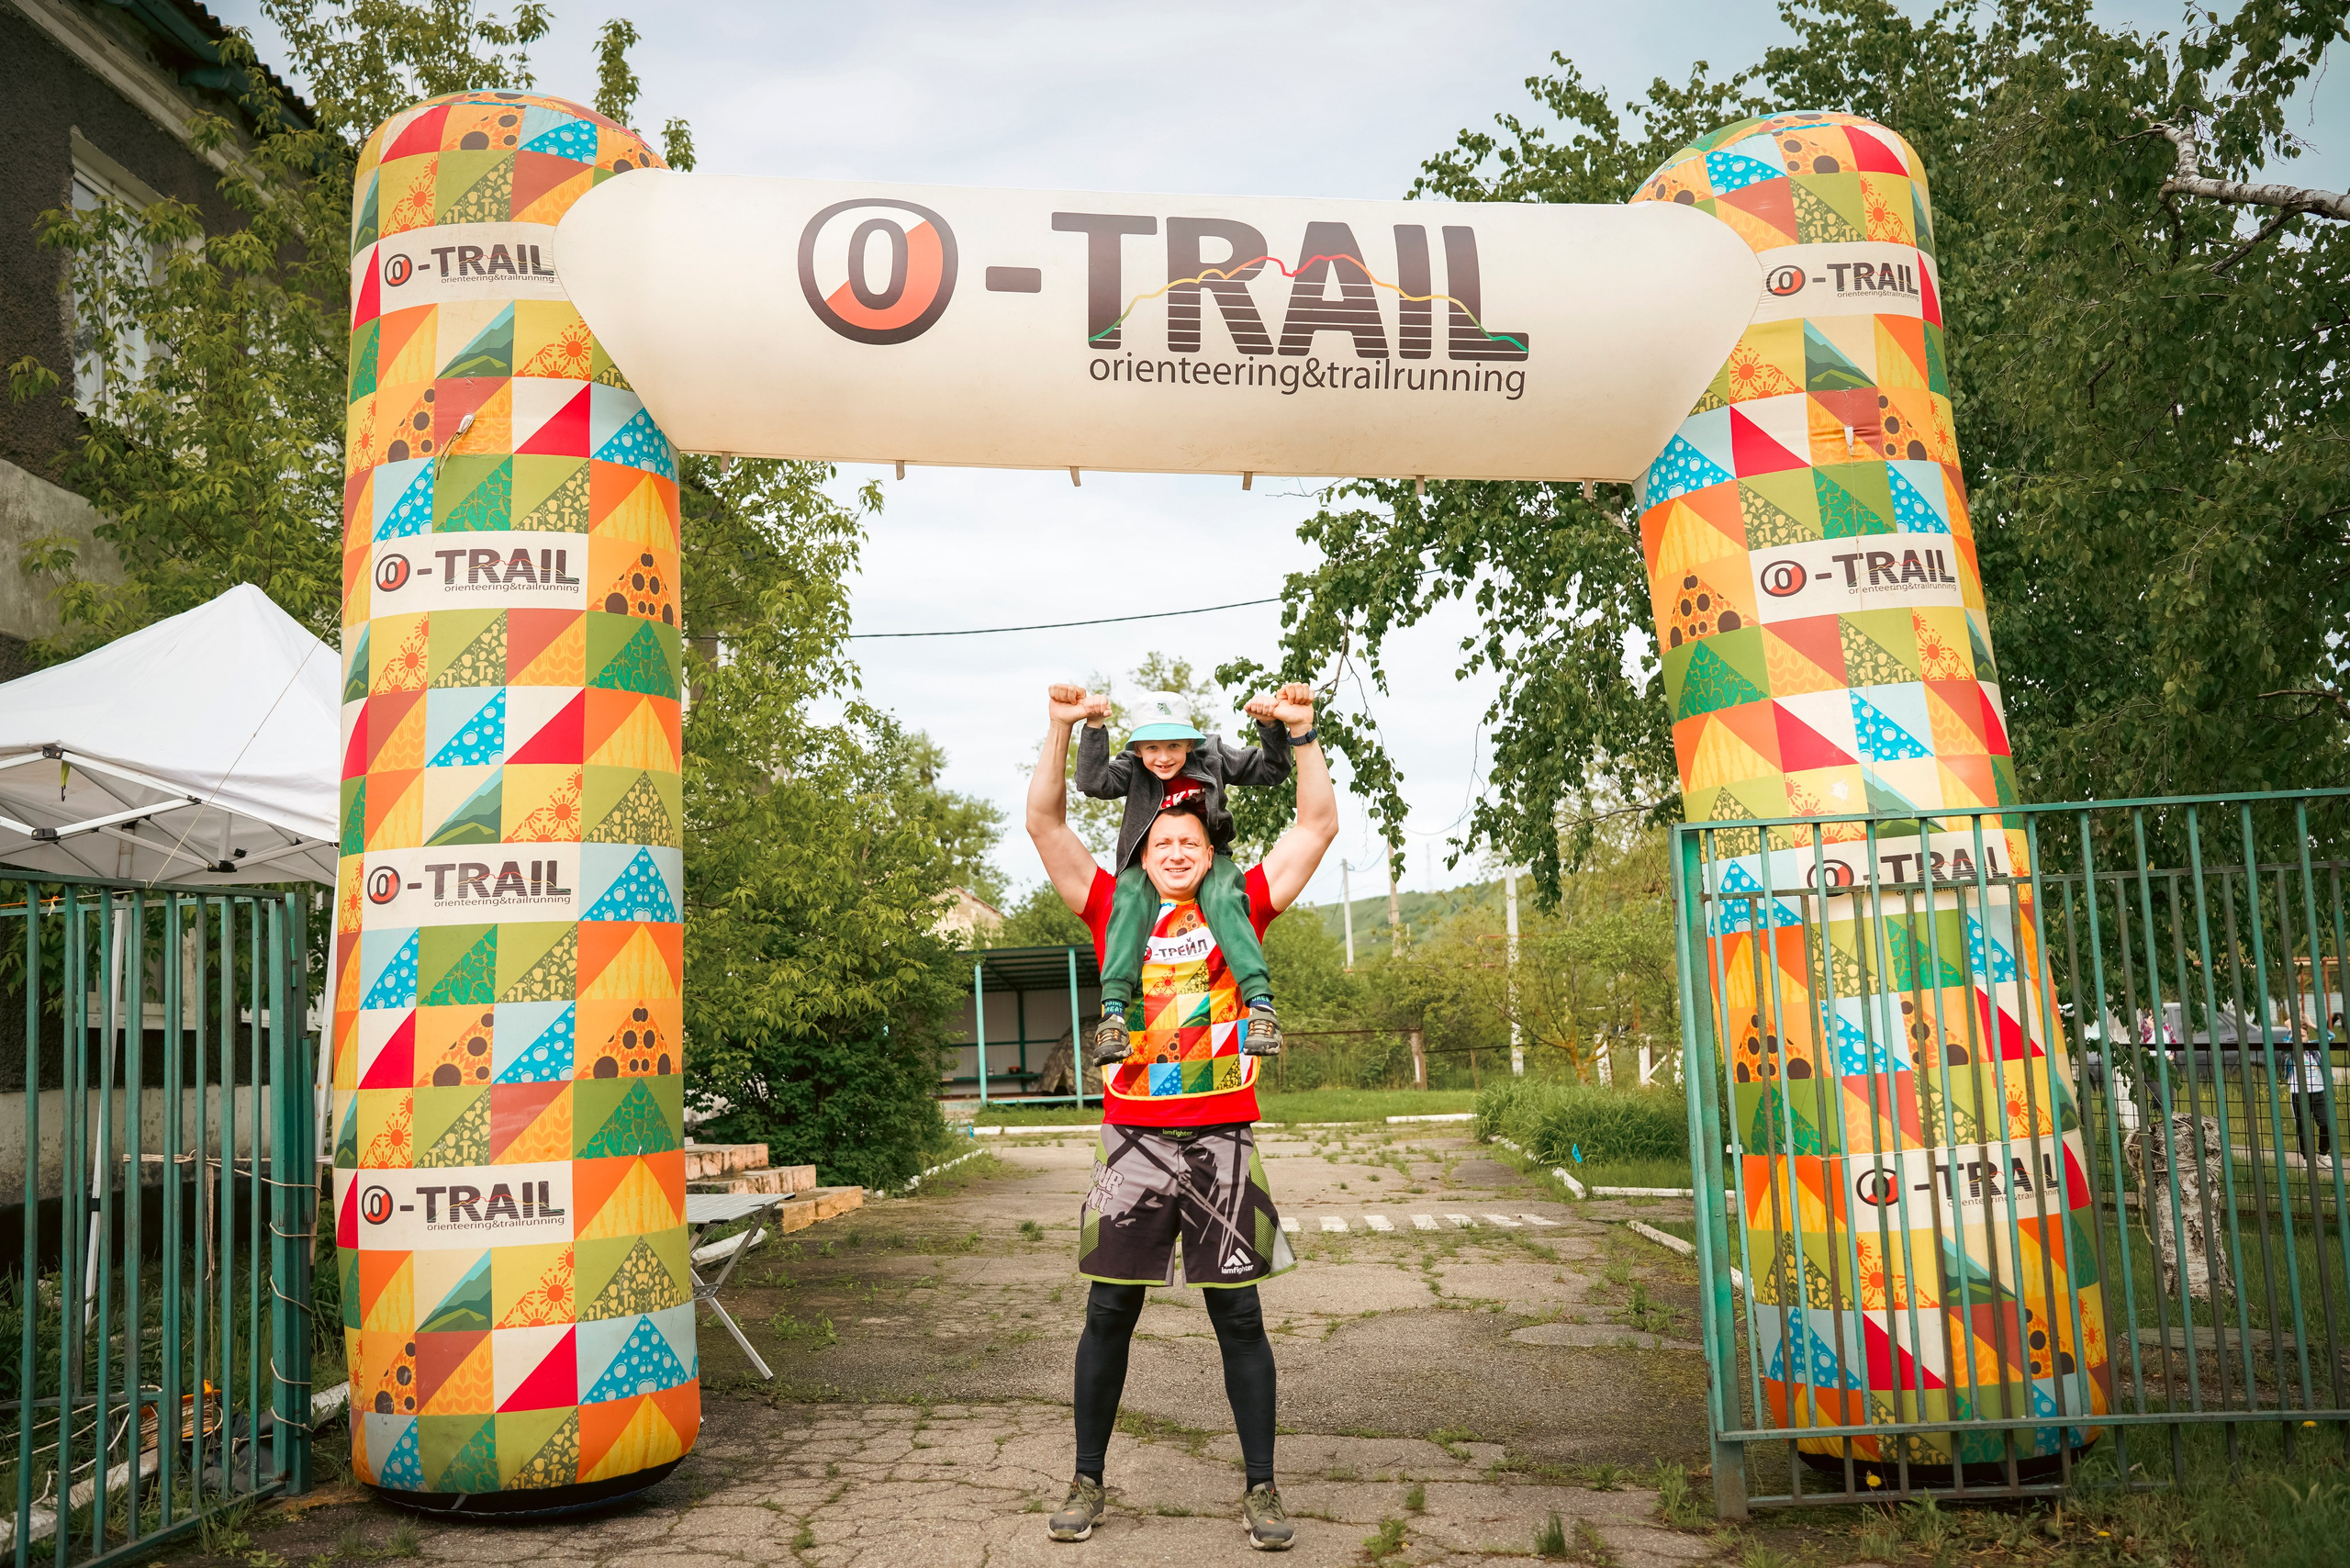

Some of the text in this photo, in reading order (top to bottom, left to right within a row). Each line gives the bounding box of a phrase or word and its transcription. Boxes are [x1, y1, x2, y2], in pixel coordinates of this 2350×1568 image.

[441, 274, 554, 284] orienteering&trailrunning
[1837, 289, 1919, 302] orienteering&trailrunning
[1089, 350, 1527, 400] orienteering&trailrunning
[444, 582, 579, 593] orienteering&trailrunning
[1848, 582, 1957, 595] orenteering&trailrunning
[434, 895, 571, 908] orienteering&trailrunning
[427, 1216, 565, 1231] orienteering&trailrunning
